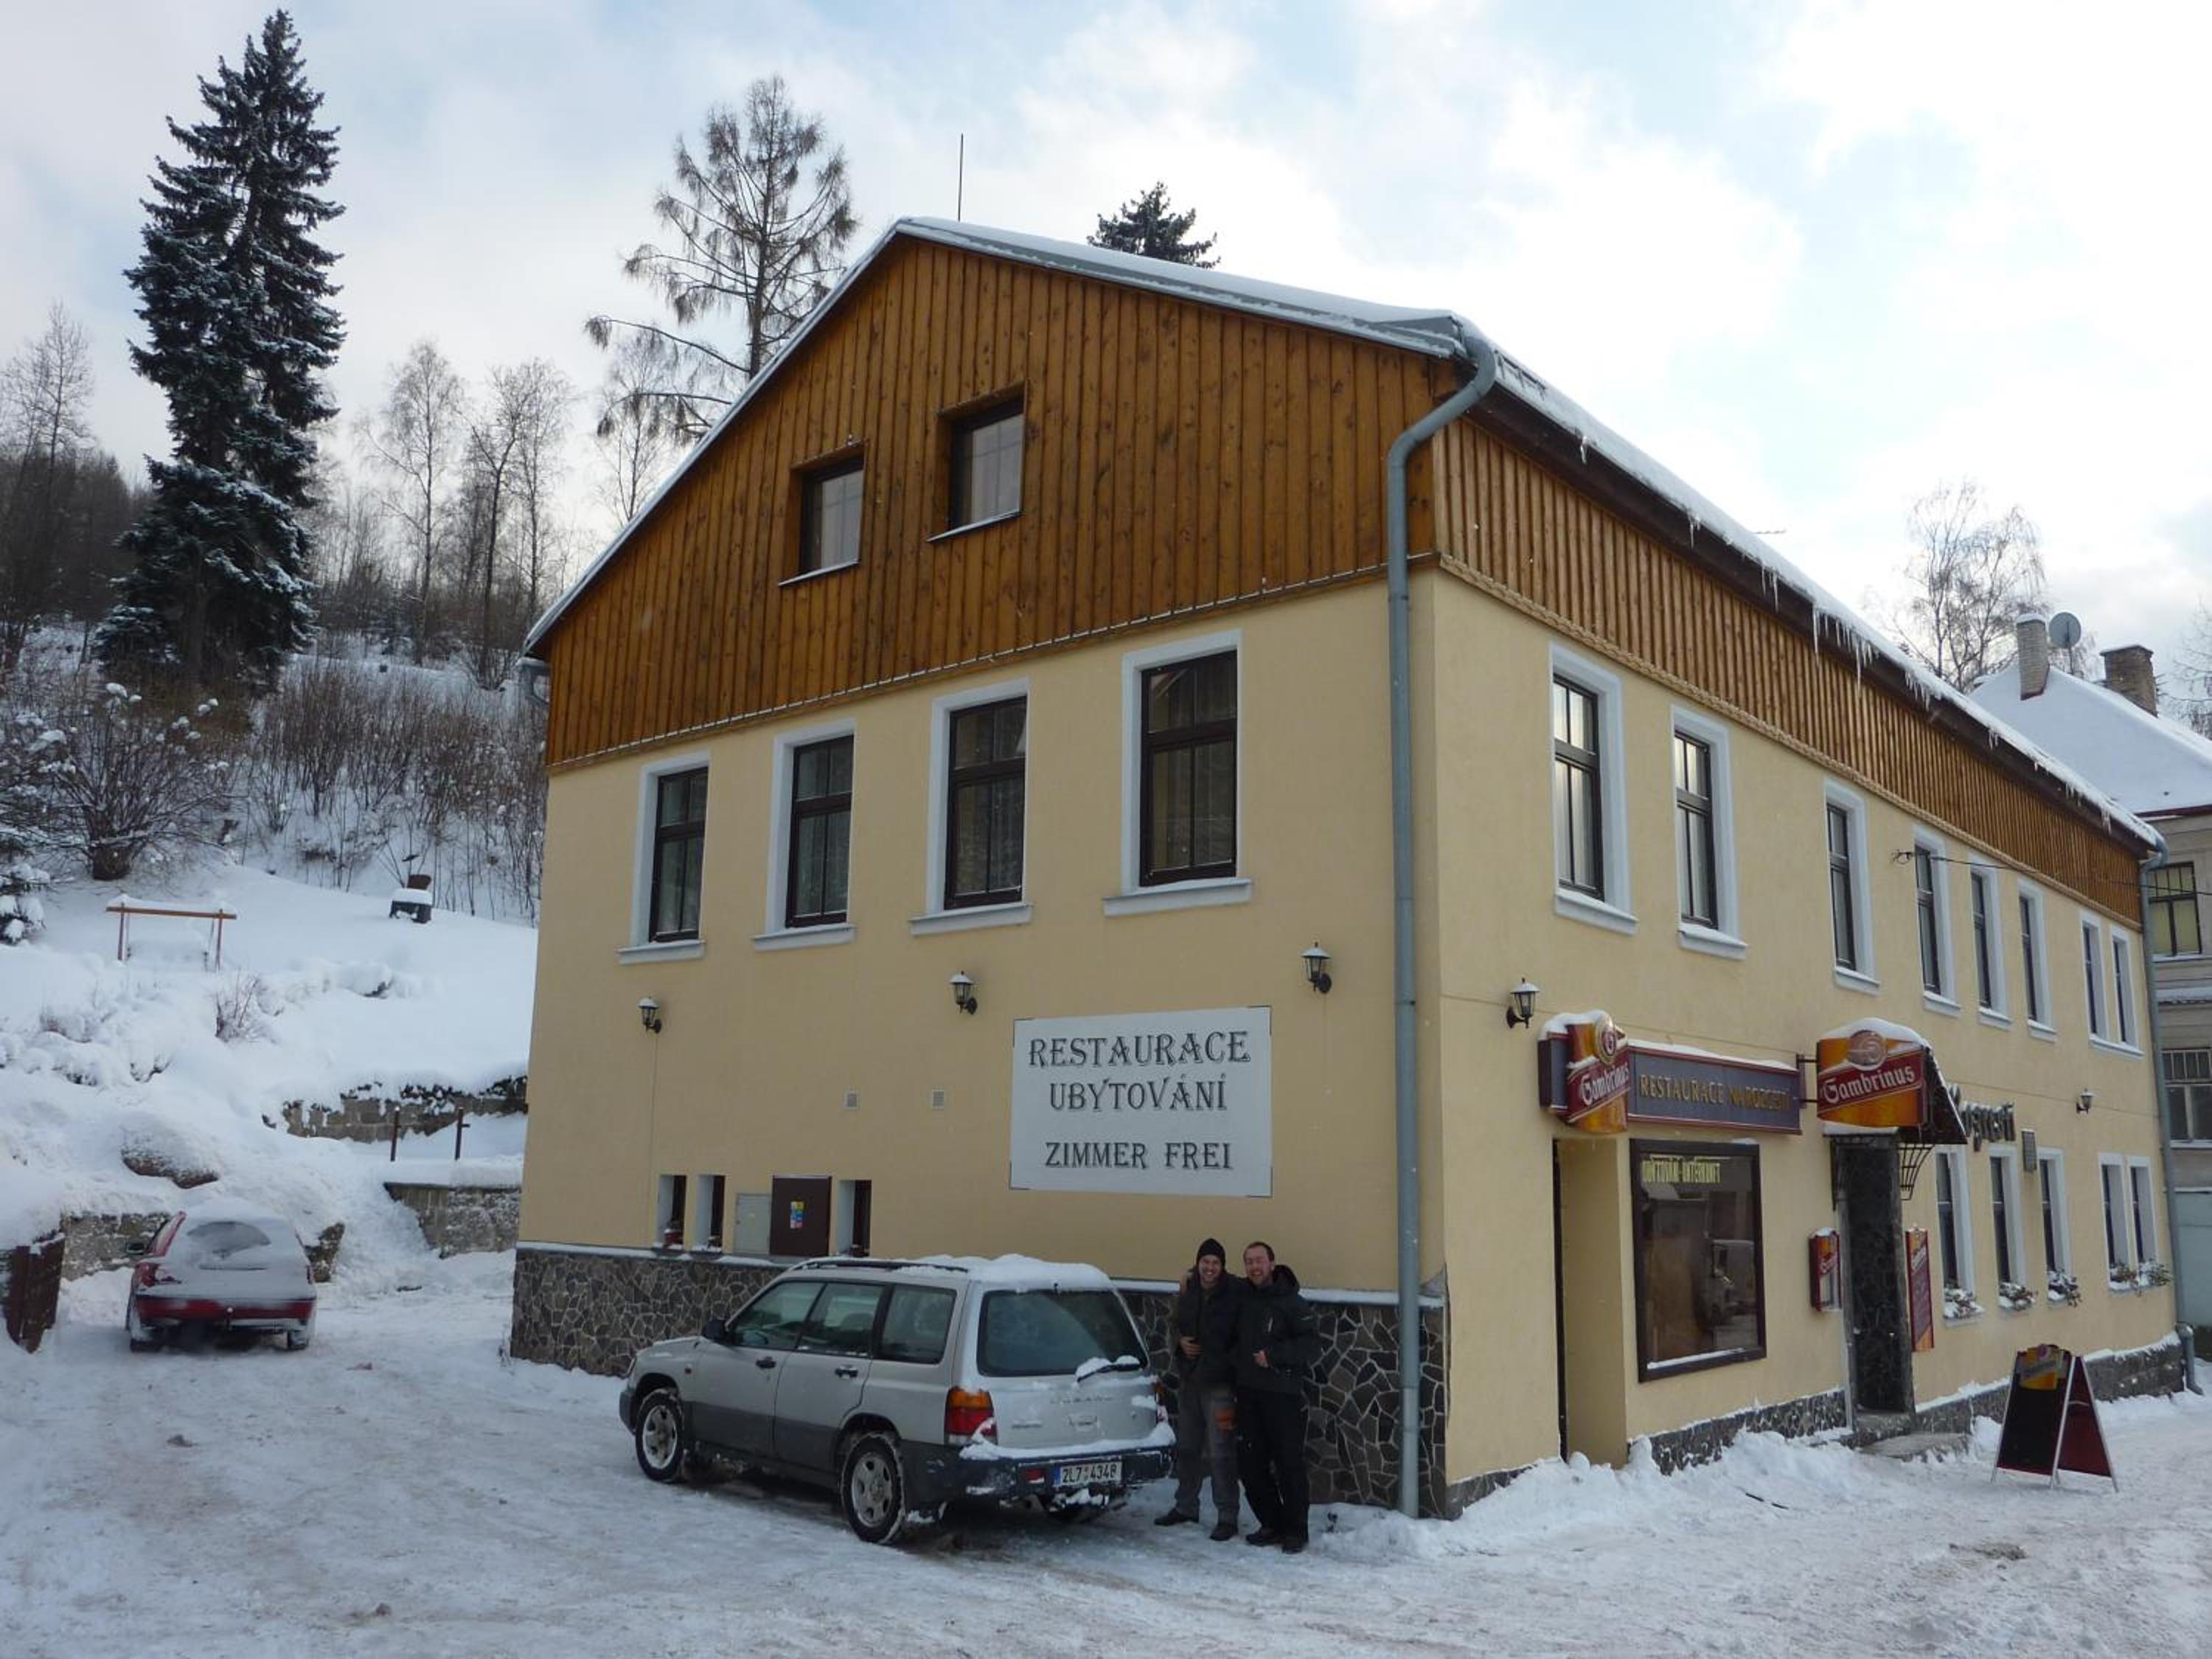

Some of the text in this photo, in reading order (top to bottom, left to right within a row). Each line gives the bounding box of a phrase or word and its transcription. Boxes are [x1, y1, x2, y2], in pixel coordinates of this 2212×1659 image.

[1029, 1031, 1252, 1068] RESTAURACE
[1050, 1073, 1228, 1111] UBYTOVÁNÍ
[1581, 1062, 1629, 1105] Gambrinus
[1640, 1074, 1723, 1105] RESTAURACE
[1823, 1066, 1916, 1104] Gambrinus
[1045, 1142, 1234, 1170] ZIMMER FREI
